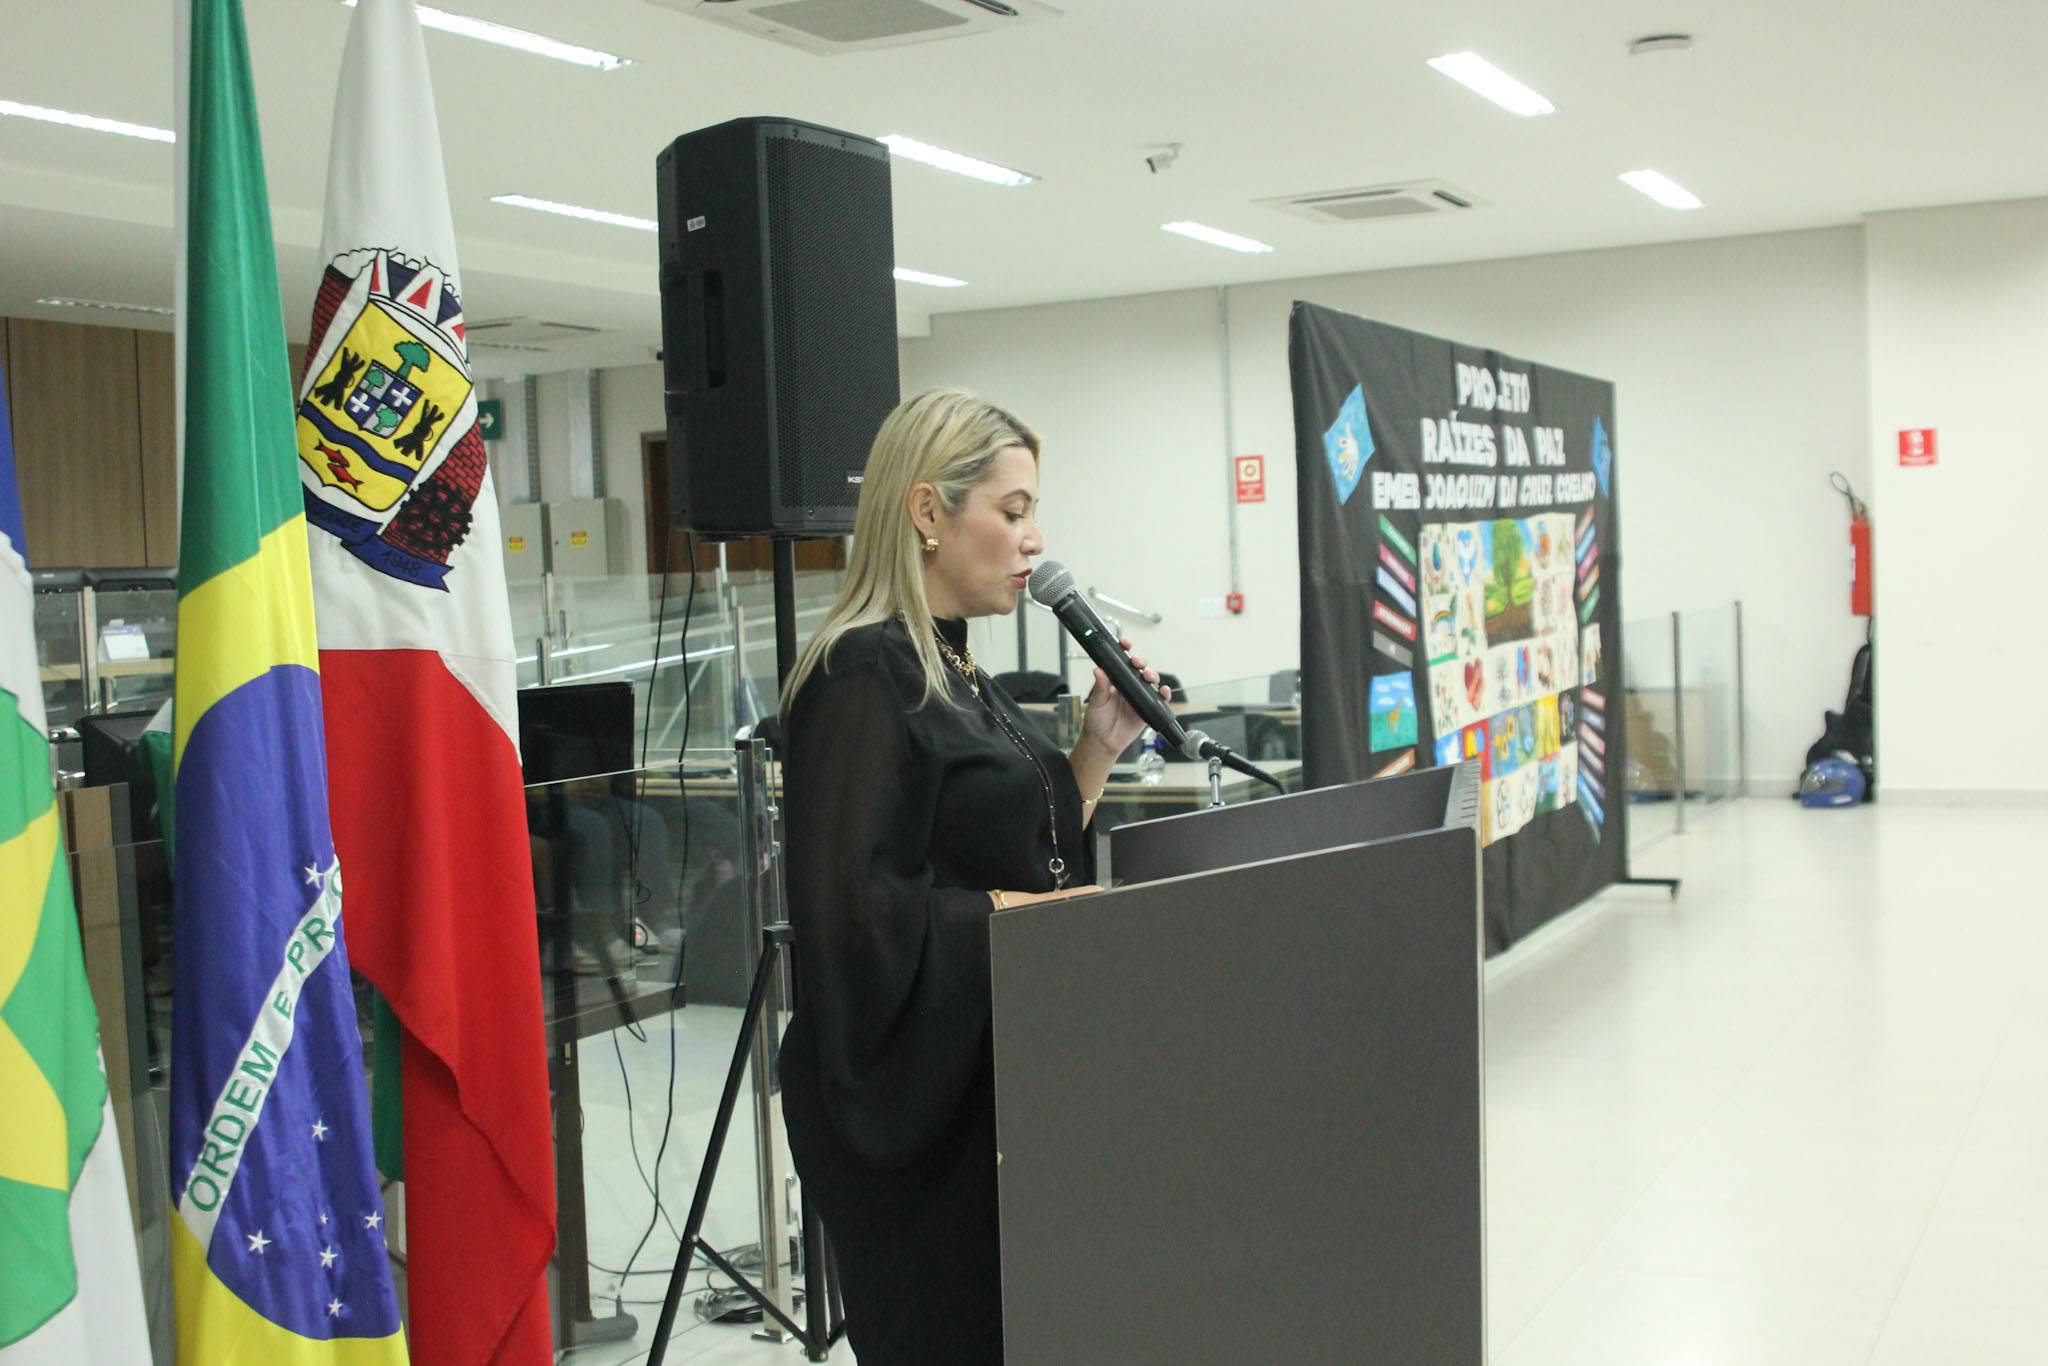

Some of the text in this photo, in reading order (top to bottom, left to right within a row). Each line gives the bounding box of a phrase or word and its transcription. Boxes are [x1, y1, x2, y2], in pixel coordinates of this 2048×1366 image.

[1456, 362, 1531, 414] PROJETO
[1420, 410, 1566, 468] RAÍZES DA PAZ
[1498, 474, 1518, 508] DA
[381, 550, 422, 578] 1948
[187, 1039, 278, 1213] ORDEM
[272, 990, 294, 1022] E
